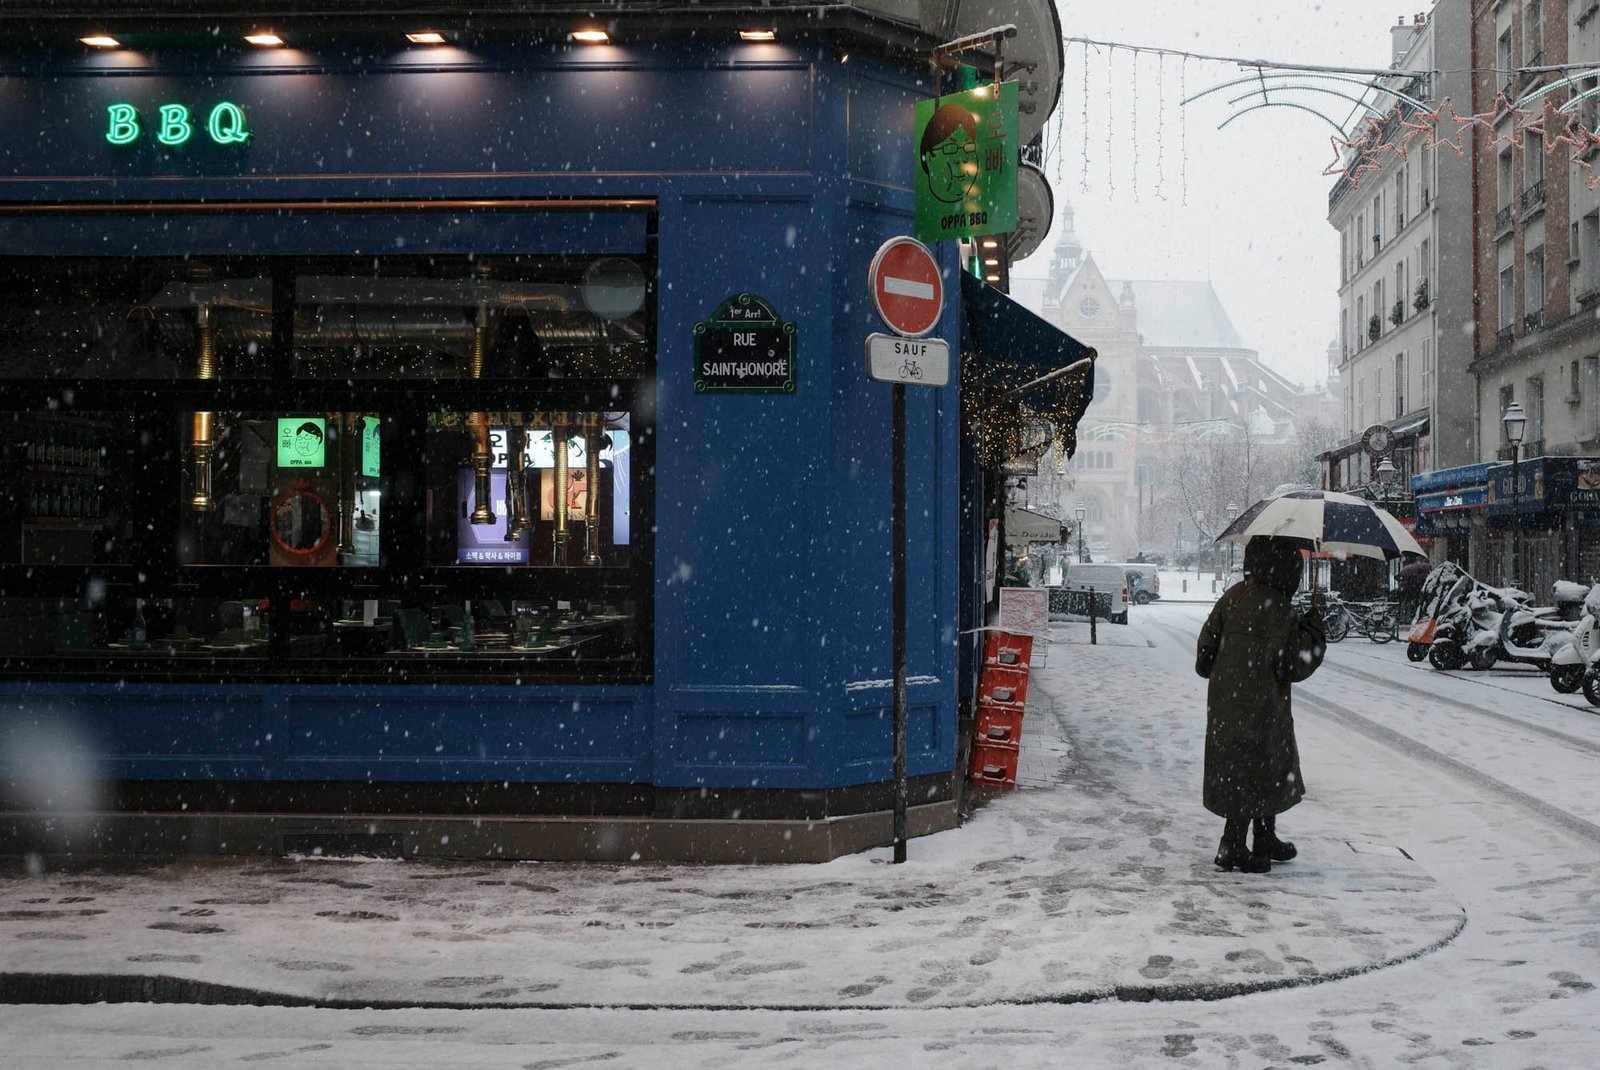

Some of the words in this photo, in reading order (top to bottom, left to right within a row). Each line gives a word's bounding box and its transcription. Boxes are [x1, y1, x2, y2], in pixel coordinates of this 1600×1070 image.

[105, 102, 250, 145] BBQ
[941, 215, 966, 230] OPPA
[969, 212, 988, 226] BBQ
[733, 332, 757, 347] RUE
[894, 342, 927, 357] SAUF
